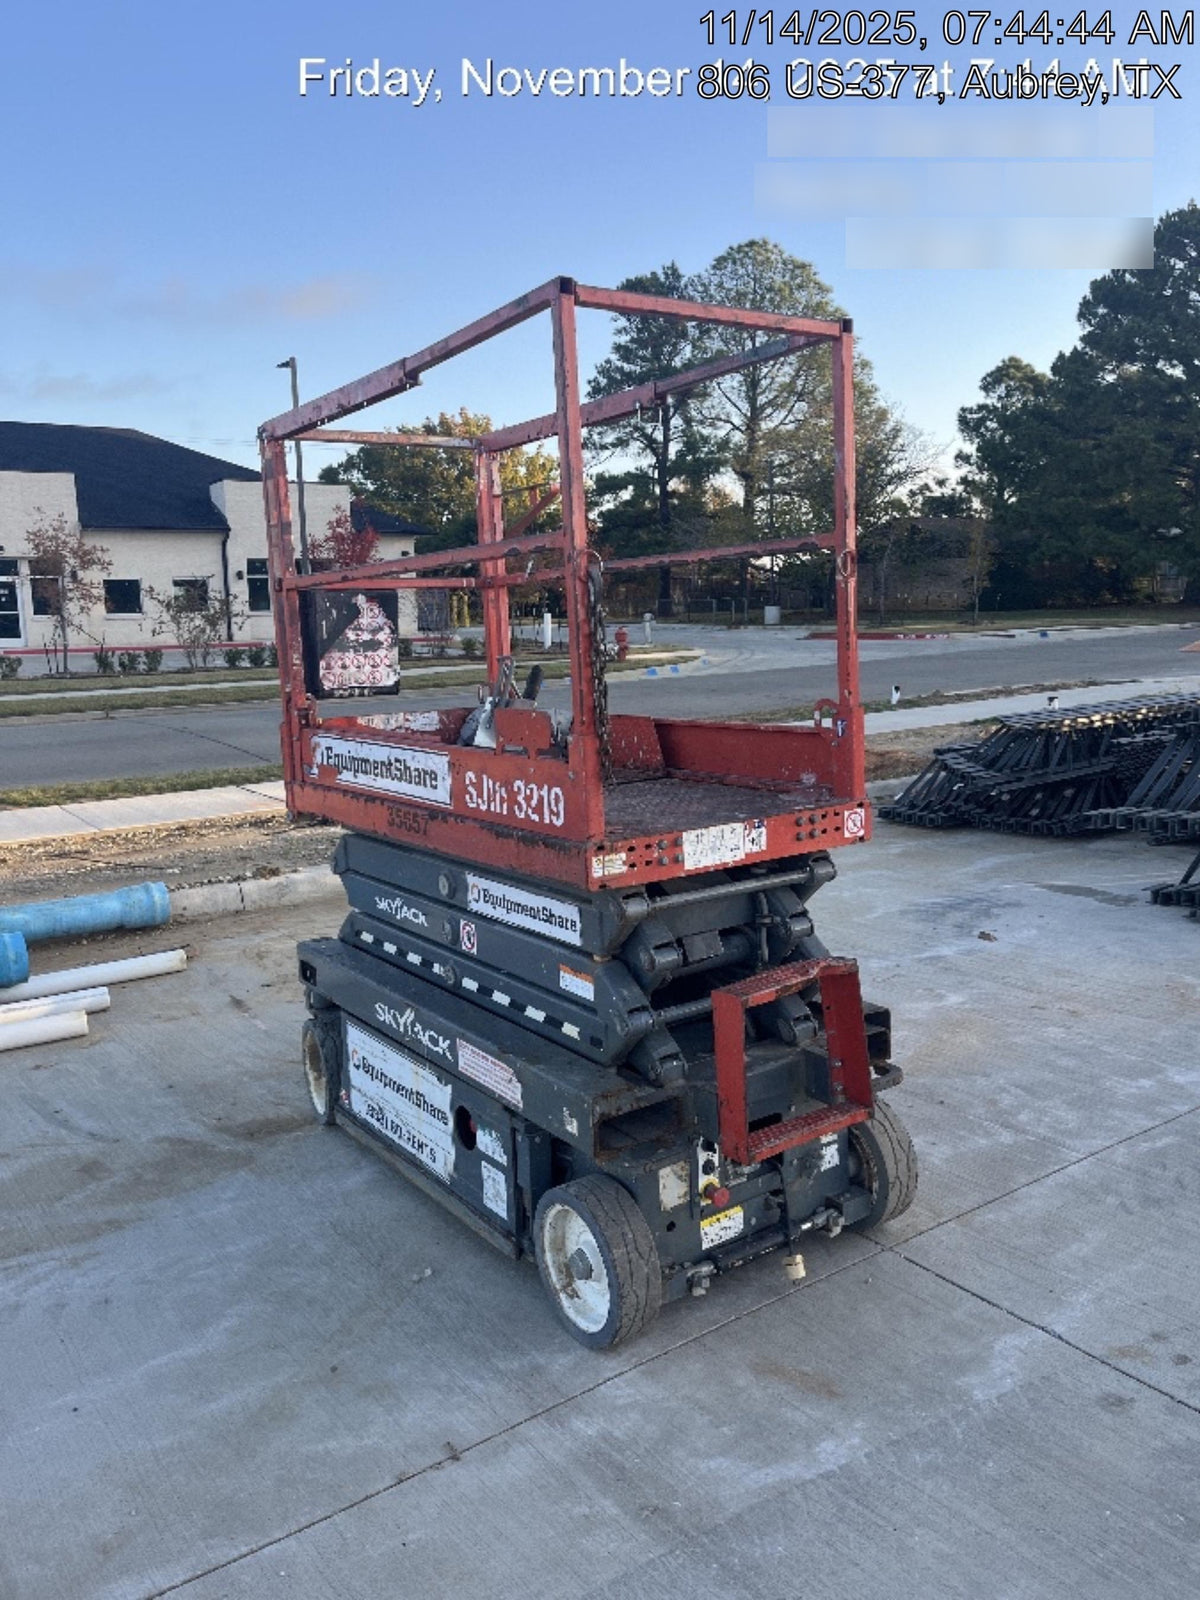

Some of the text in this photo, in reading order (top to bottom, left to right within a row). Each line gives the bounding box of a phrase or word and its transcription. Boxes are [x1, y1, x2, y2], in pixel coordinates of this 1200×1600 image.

[325, 746, 439, 790] EquipmentShare
[513, 779, 565, 827] 3219
[375, 897, 427, 927] SKYJACK
[482, 888, 578, 932] EquipmentShare
[361, 1055, 449, 1126] EquipmentShare
